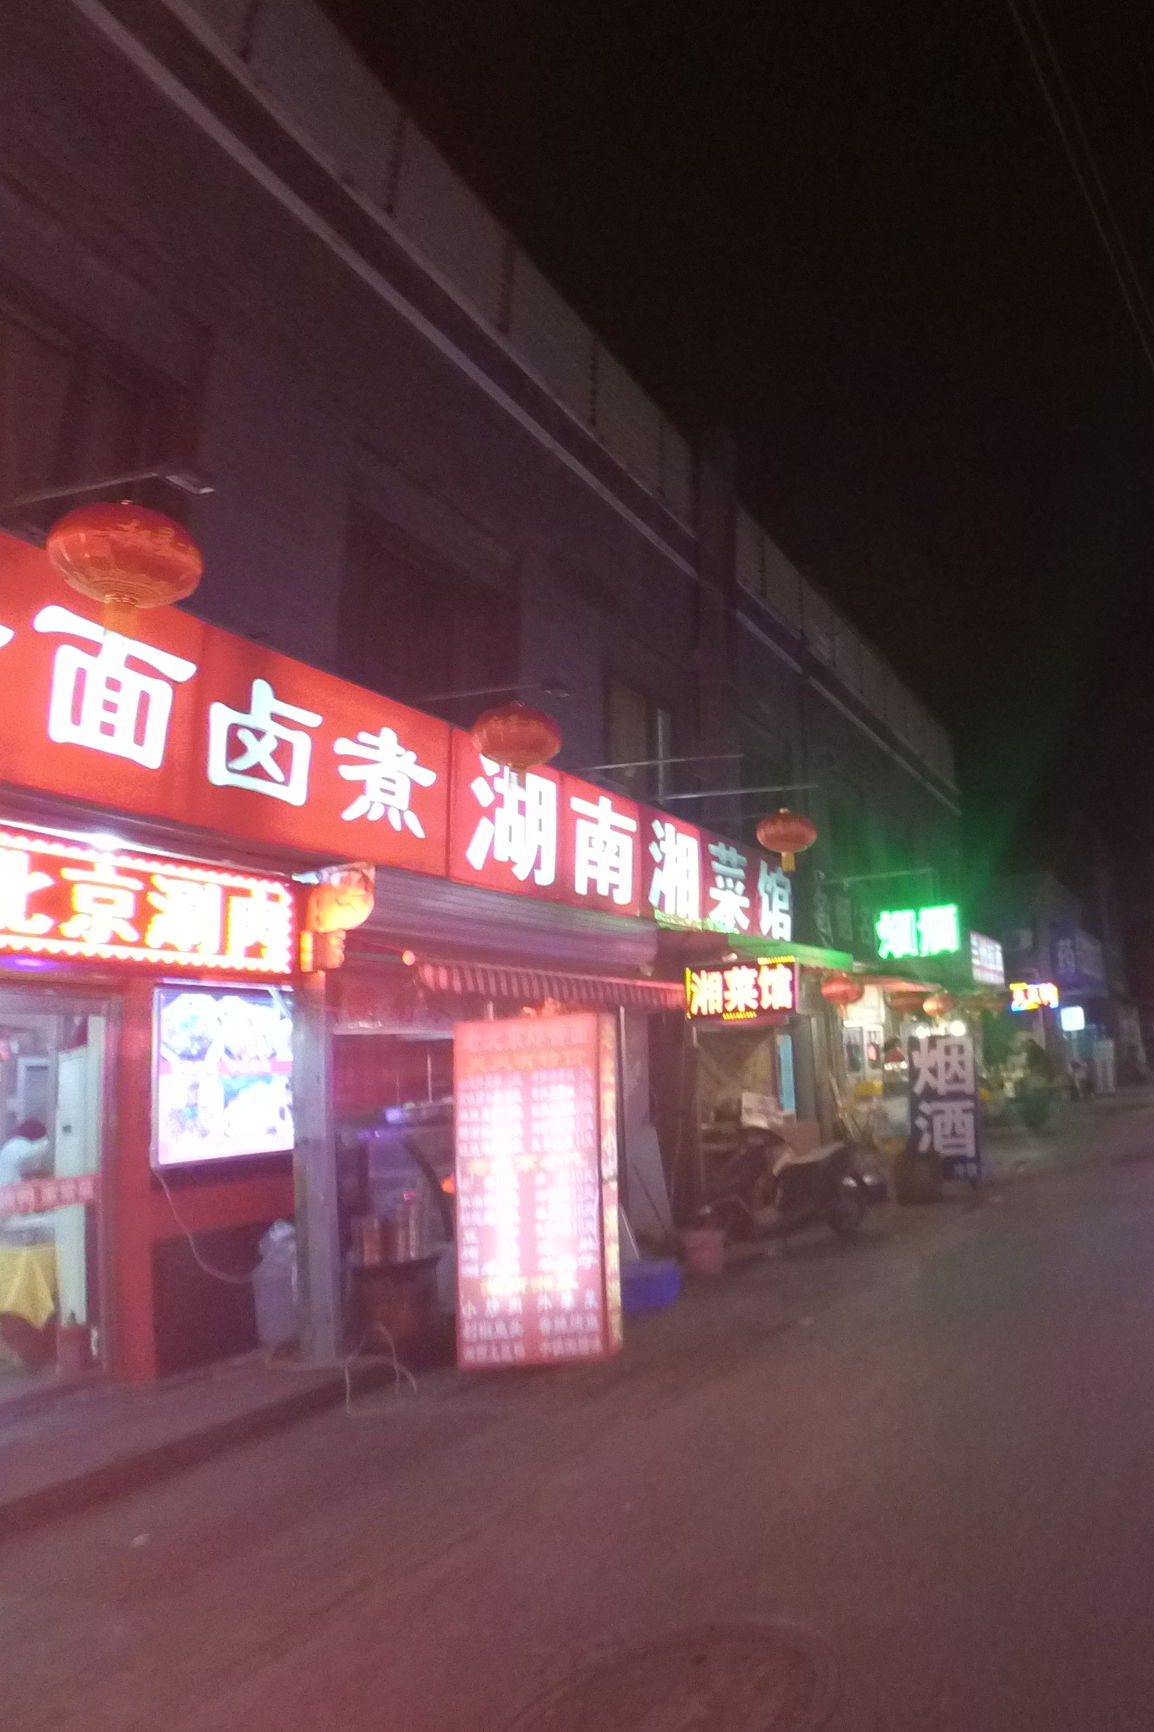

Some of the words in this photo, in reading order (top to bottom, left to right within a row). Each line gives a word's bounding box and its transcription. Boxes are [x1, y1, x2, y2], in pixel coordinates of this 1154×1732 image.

[0, 605, 437, 839] 面卤煮
[466, 753, 794, 941] 湖南湘菜馆
[690, 963, 793, 1015] 湘菜馆
[909, 1036, 976, 1157] 烟酒
